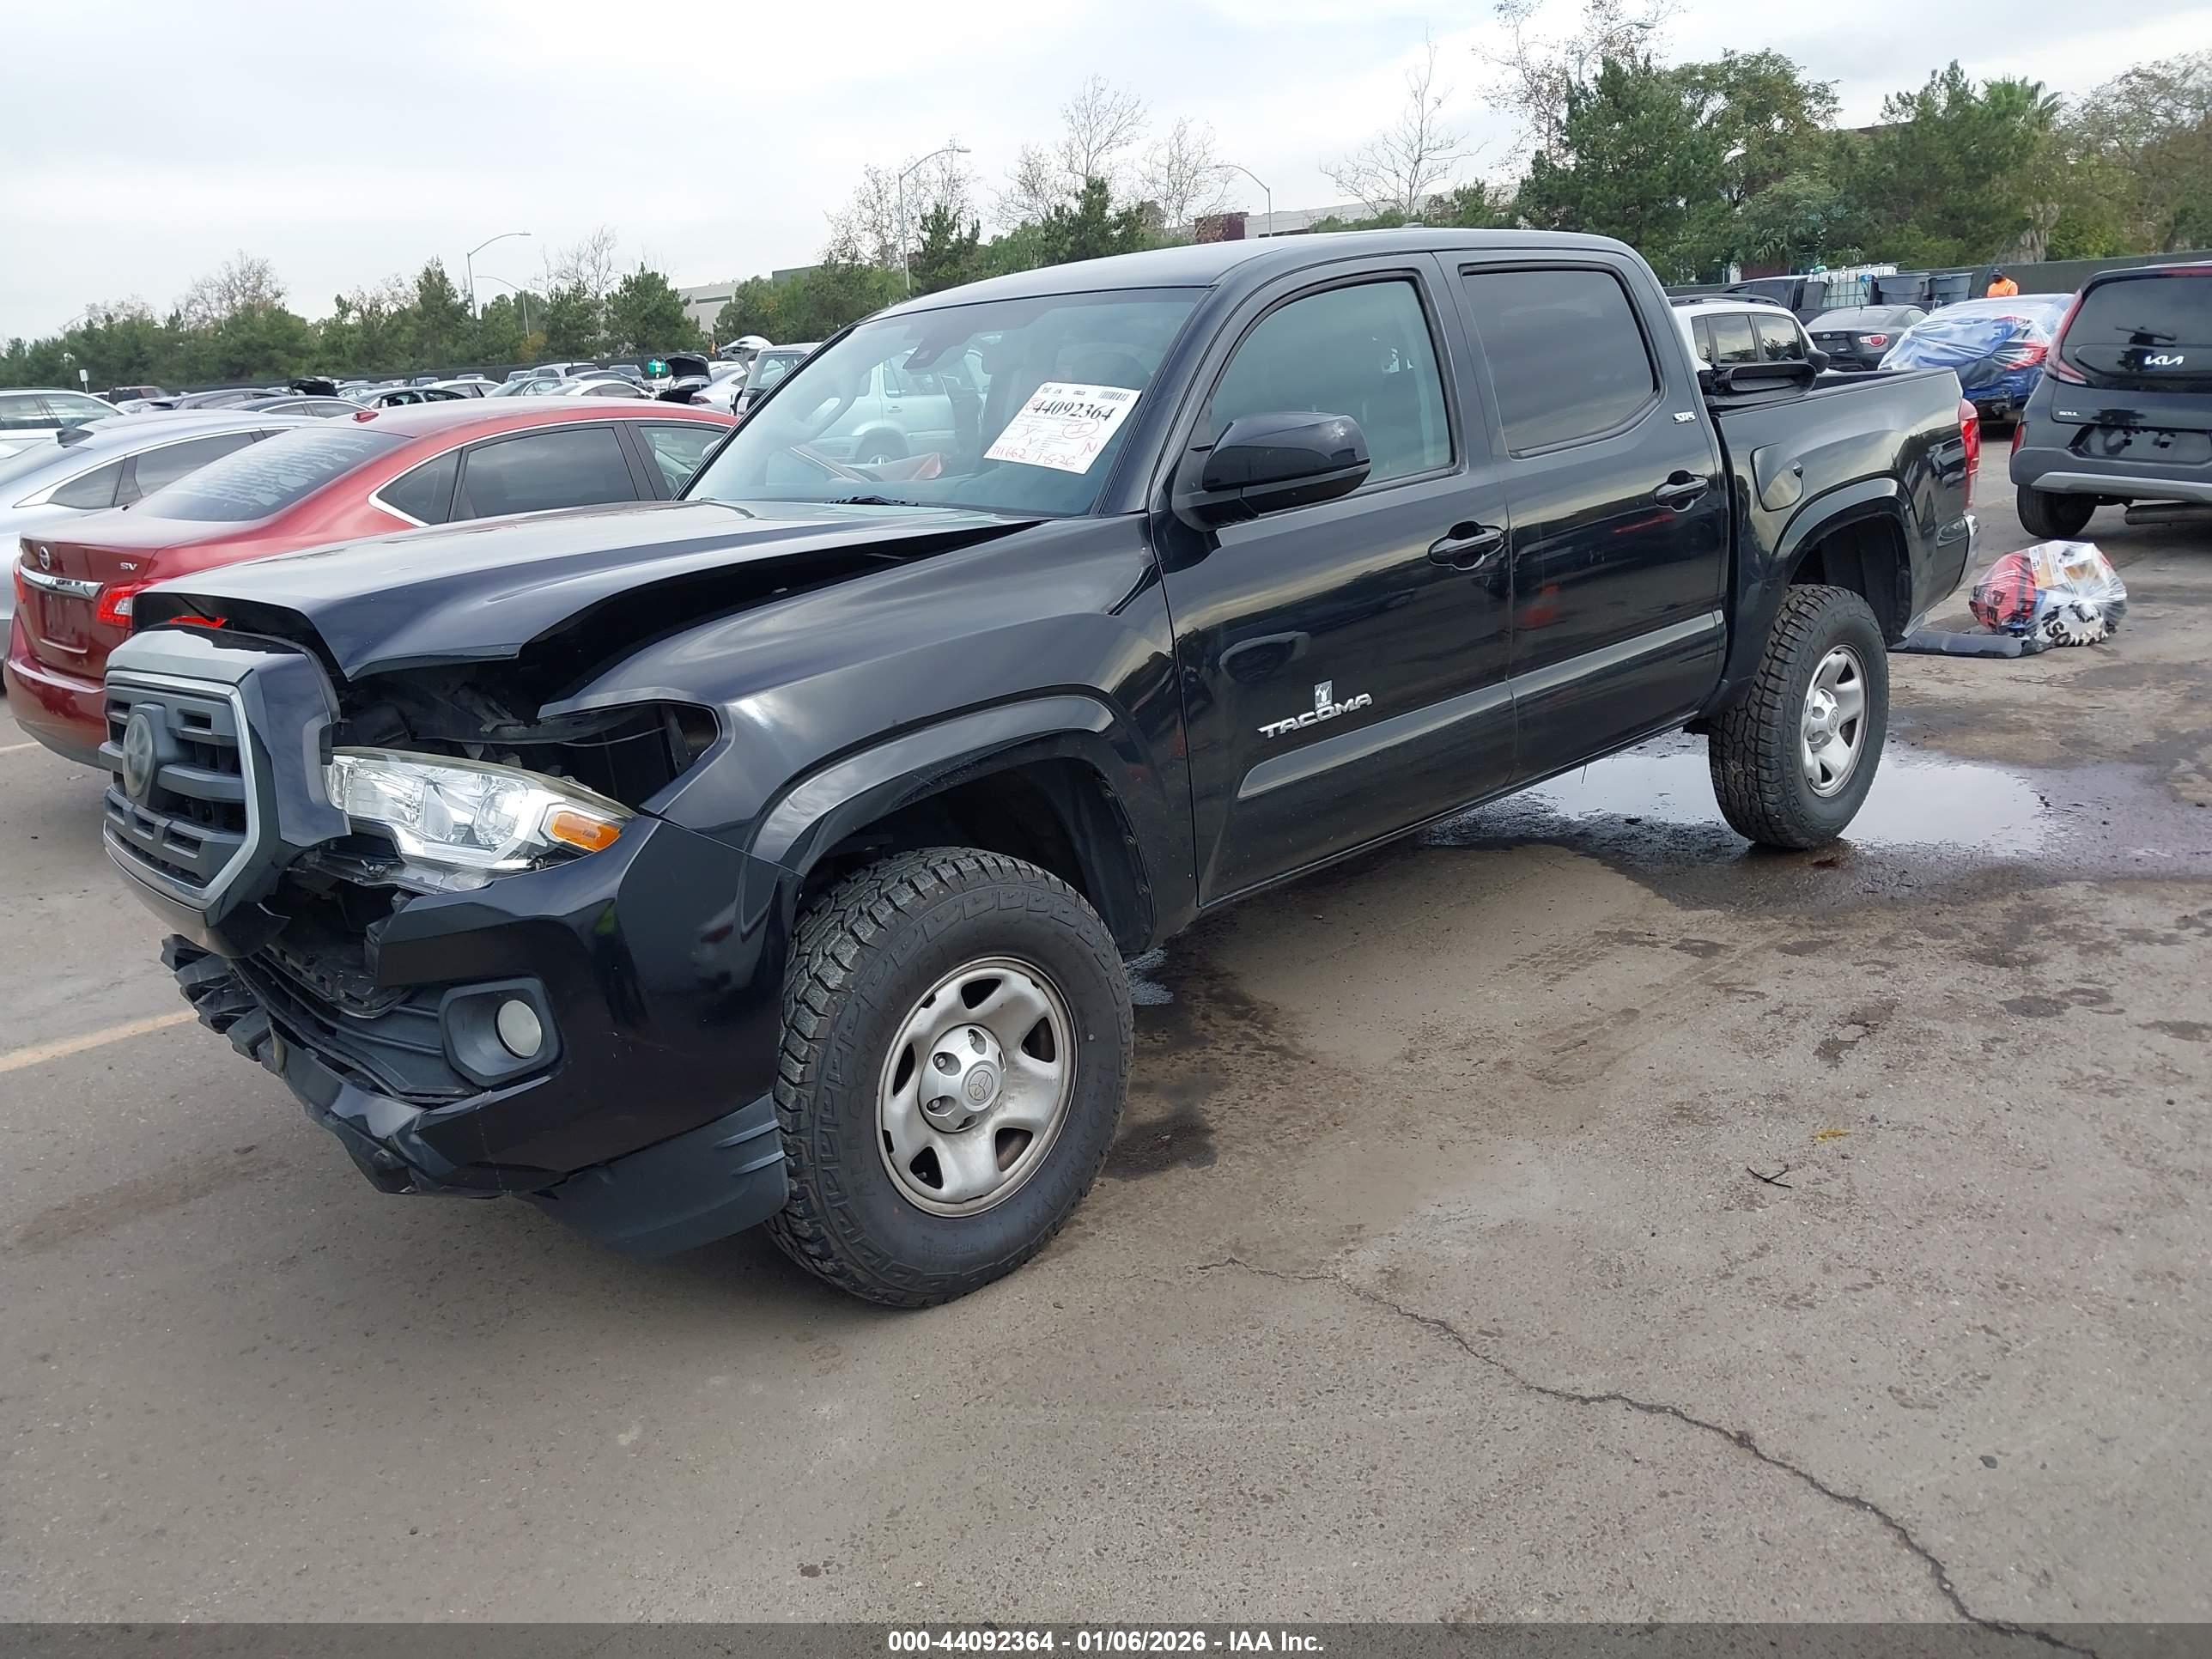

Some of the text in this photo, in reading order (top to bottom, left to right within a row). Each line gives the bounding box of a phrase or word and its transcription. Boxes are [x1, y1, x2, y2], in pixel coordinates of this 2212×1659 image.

[2145, 356, 2185, 366] KIA
[1033, 400, 1116, 421] 44092364
[119, 562, 138, 571] SV
[1257, 693, 1373, 739] TACOMA
